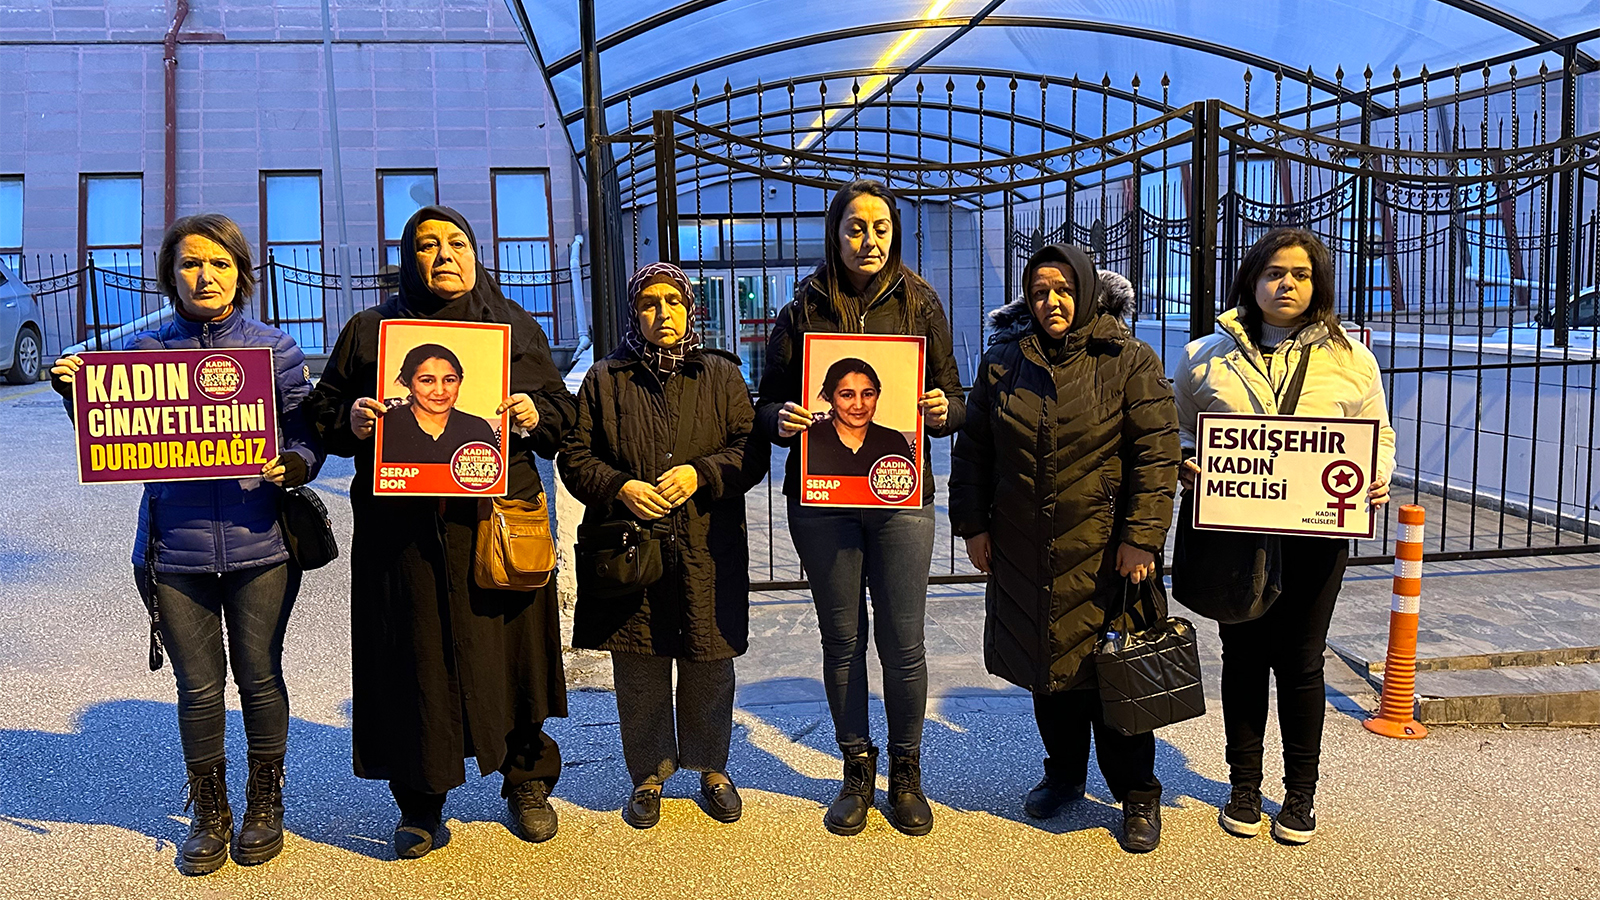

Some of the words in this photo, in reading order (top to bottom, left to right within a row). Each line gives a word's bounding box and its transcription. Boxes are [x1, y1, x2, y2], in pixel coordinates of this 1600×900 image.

[86, 363, 190, 402] KADIN
[88, 398, 266, 438] CİNAYETLERİNİ
[1208, 424, 1346, 458] ESKİŞEHİR
[90, 434, 268, 472] DURDURACAĞIZ
[380, 467, 420, 478] SERAP
[1208, 456, 1274, 476] KADIN
[380, 479, 406, 490] BOR
[806, 479, 840, 490] SERAP
[1206, 478, 1287, 500] MECLİSİ
[806, 490, 830, 501] BOR
[1302, 517, 1336, 525] MECLİSLERİ
